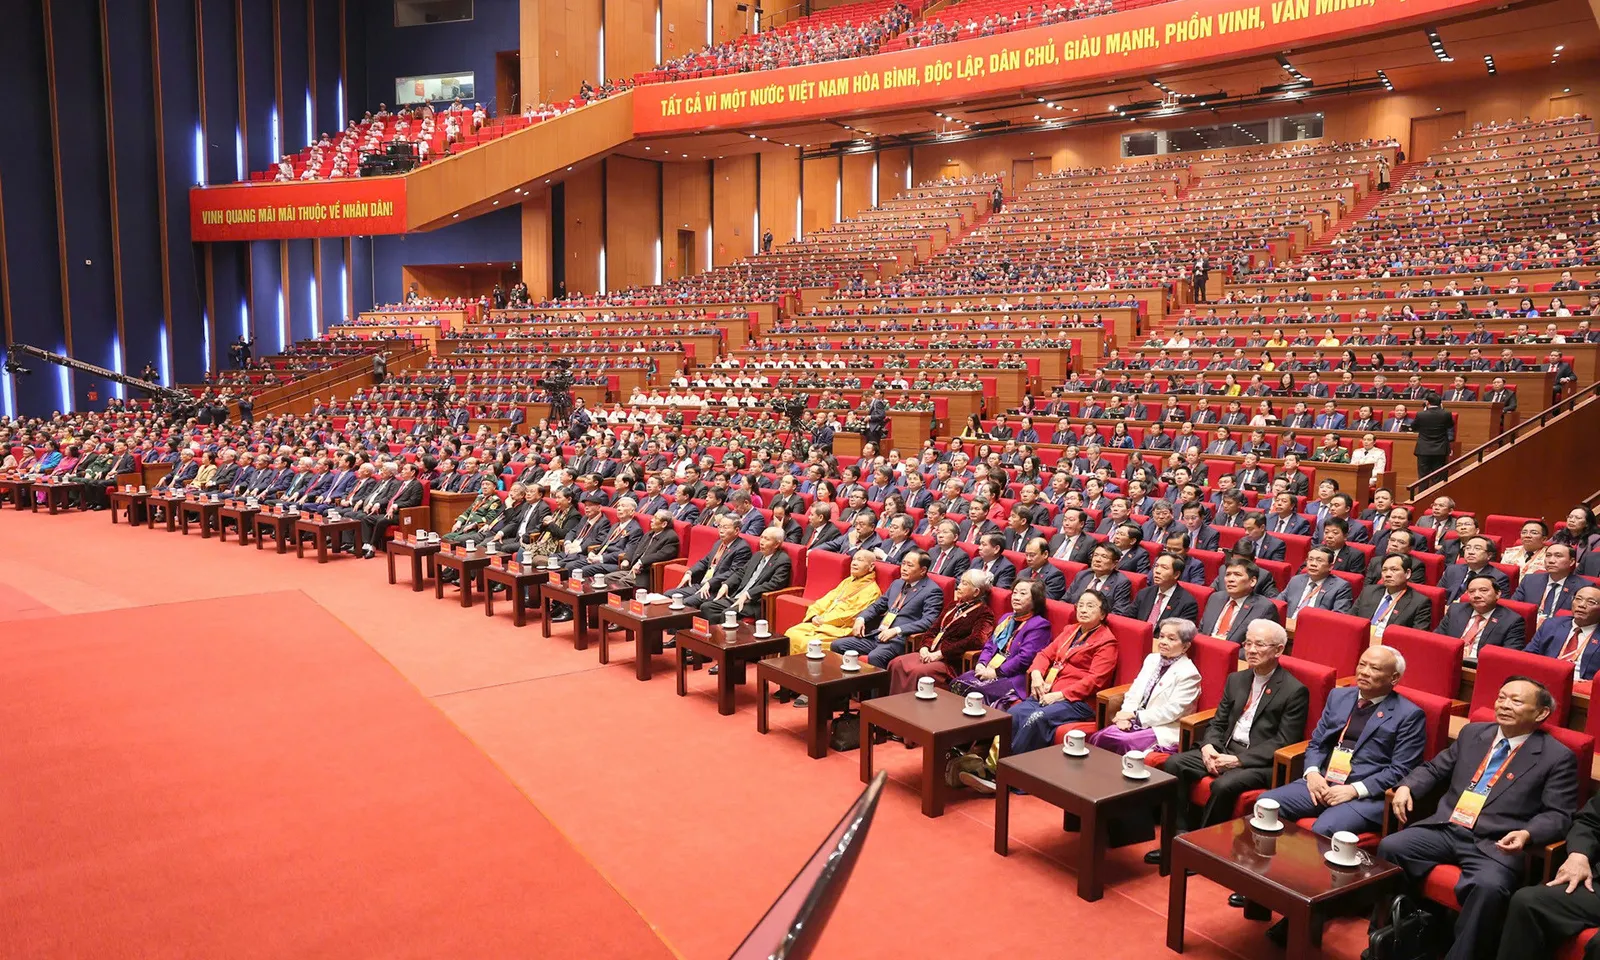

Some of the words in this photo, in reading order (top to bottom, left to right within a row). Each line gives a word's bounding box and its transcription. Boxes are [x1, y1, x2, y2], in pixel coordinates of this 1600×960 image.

[661, 93, 682, 116] TẤT
[685, 91, 702, 114] CẢ
[705, 92, 717, 112] VÌ
[720, 88, 747, 112] MỘT
[750, 83, 785, 106] NƯỚC
[788, 79, 816, 104] VIỆT
[818, 77, 849, 98] NAM
[853, 71, 880, 93] HÒA
[883, 66, 921, 89] BÌNH,
[924, 59, 953, 85] ĐỘC
[956, 54, 985, 81] LẬP,
[989, 48, 1020, 73] DÂN
[1024, 38, 1060, 68] CHỦ,
[1064, 34, 1101, 61] GIÀU
[1105, 26, 1160, 57] MẠNH,
[1165, 11, 1213, 45] PHỒN
[1217, 6, 1265, 35] VINH,
[202, 210, 224, 225] VINH
[225, 208, 256, 225] QUANG
[258, 205, 276, 222] MÃI
[278, 204, 296, 222] MÃI
[298, 203, 327, 223] THUỘC
[342, 200, 368, 218] NHÂN
[370, 199, 393, 217] DÂN!
